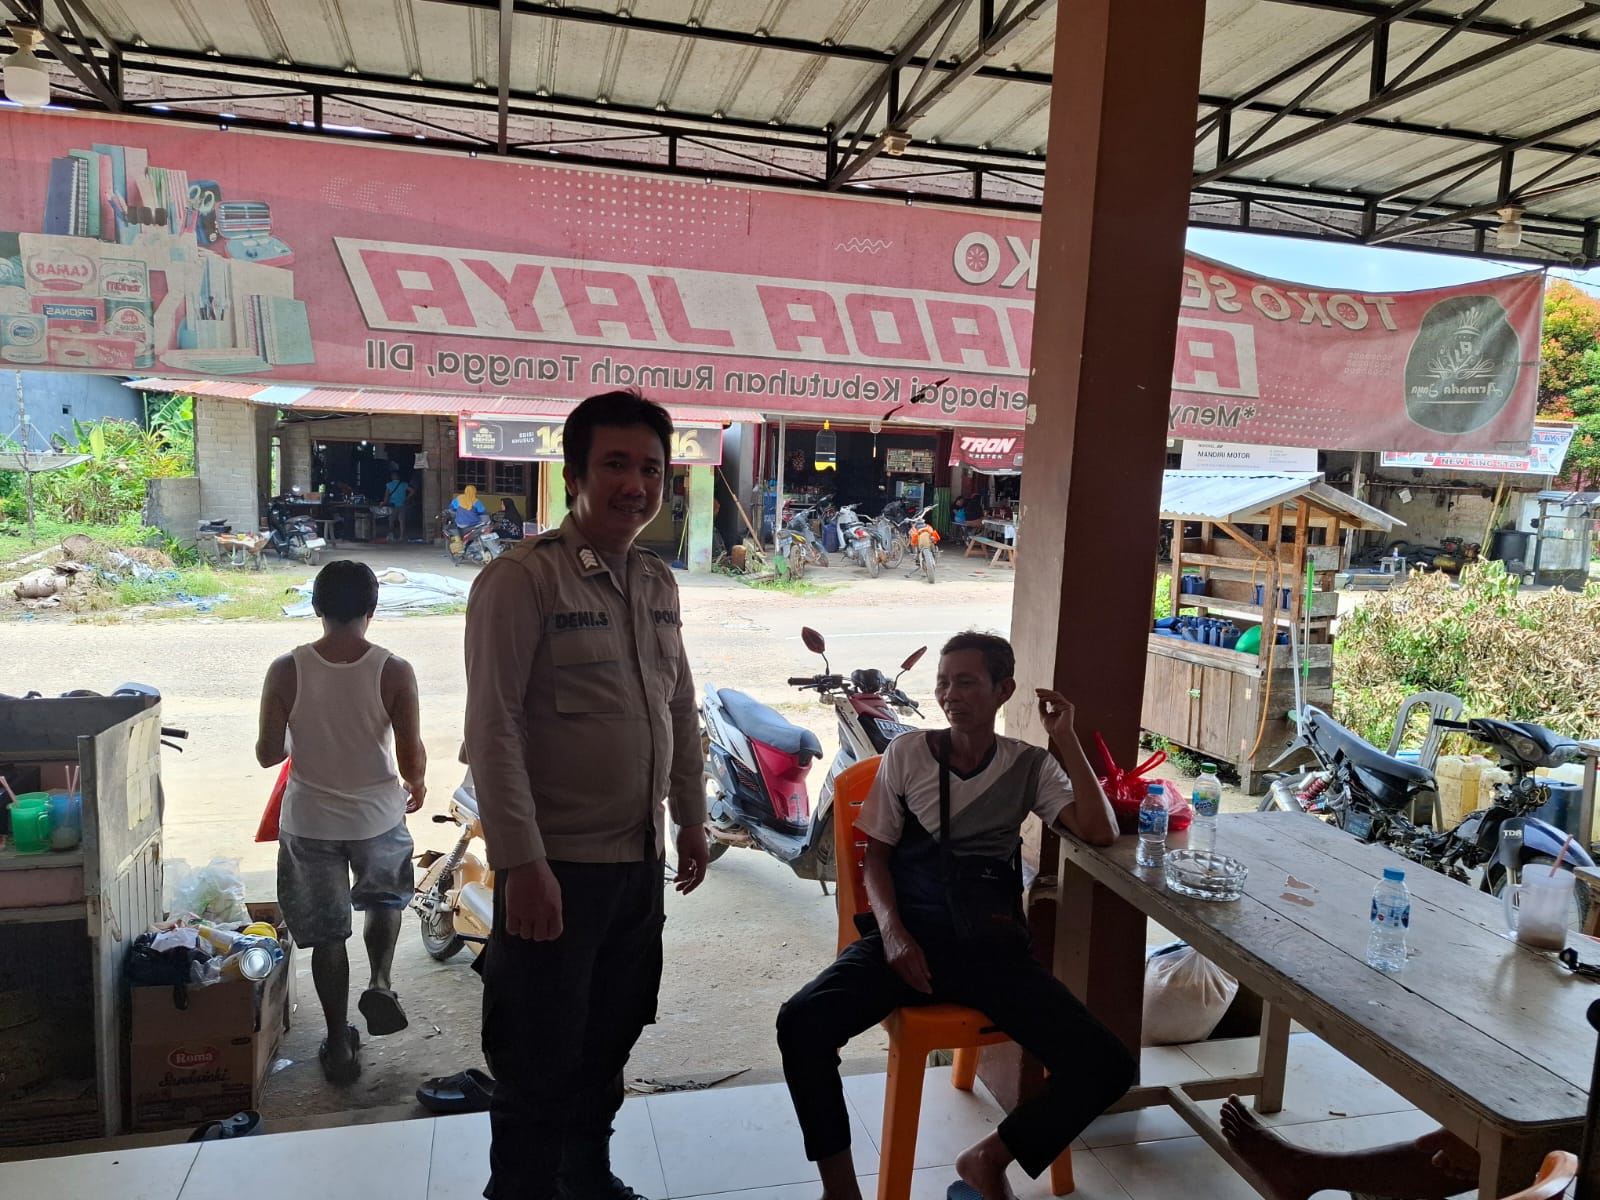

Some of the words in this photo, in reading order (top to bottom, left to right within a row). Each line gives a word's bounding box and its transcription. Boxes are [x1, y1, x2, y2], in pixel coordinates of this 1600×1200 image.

[960, 436, 1017, 454] TRON
[1227, 452, 1251, 460] MOTOR
[176, 1051, 213, 1064] Roma
